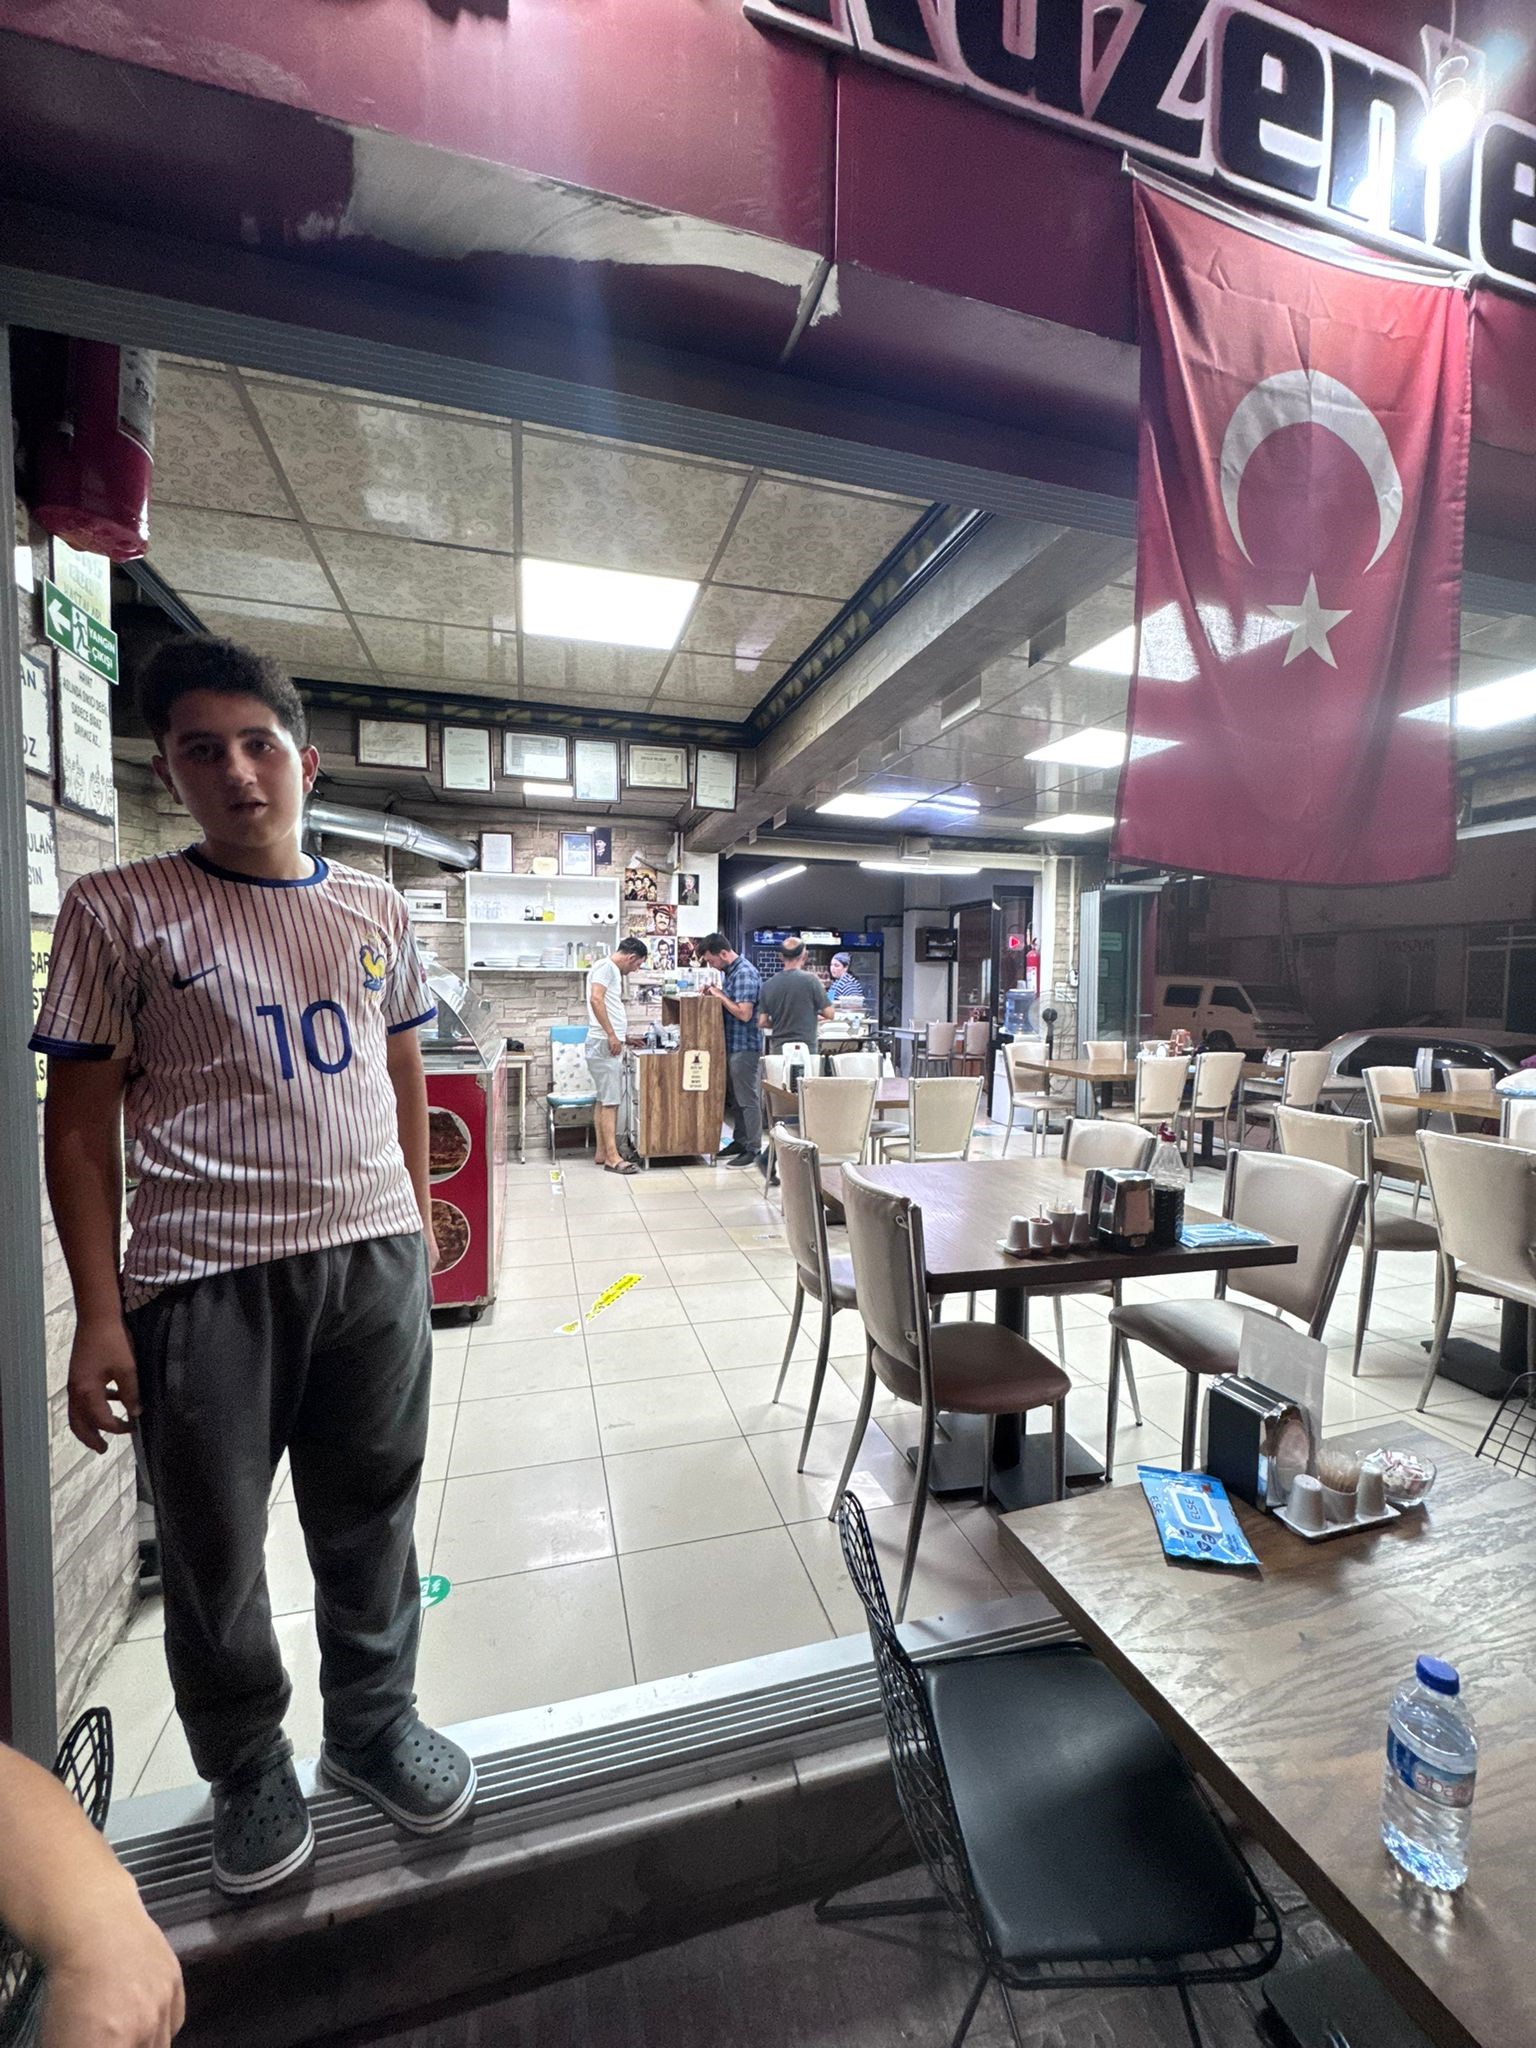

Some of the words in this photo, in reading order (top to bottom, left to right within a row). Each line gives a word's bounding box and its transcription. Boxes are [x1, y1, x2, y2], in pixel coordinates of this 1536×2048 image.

[745, 0, 1536, 280] uzenle
[89, 626, 116, 654] YANGIN
[92, 647, 113, 671] ÇIKIŞI
[256, 1000, 352, 1080] 10
